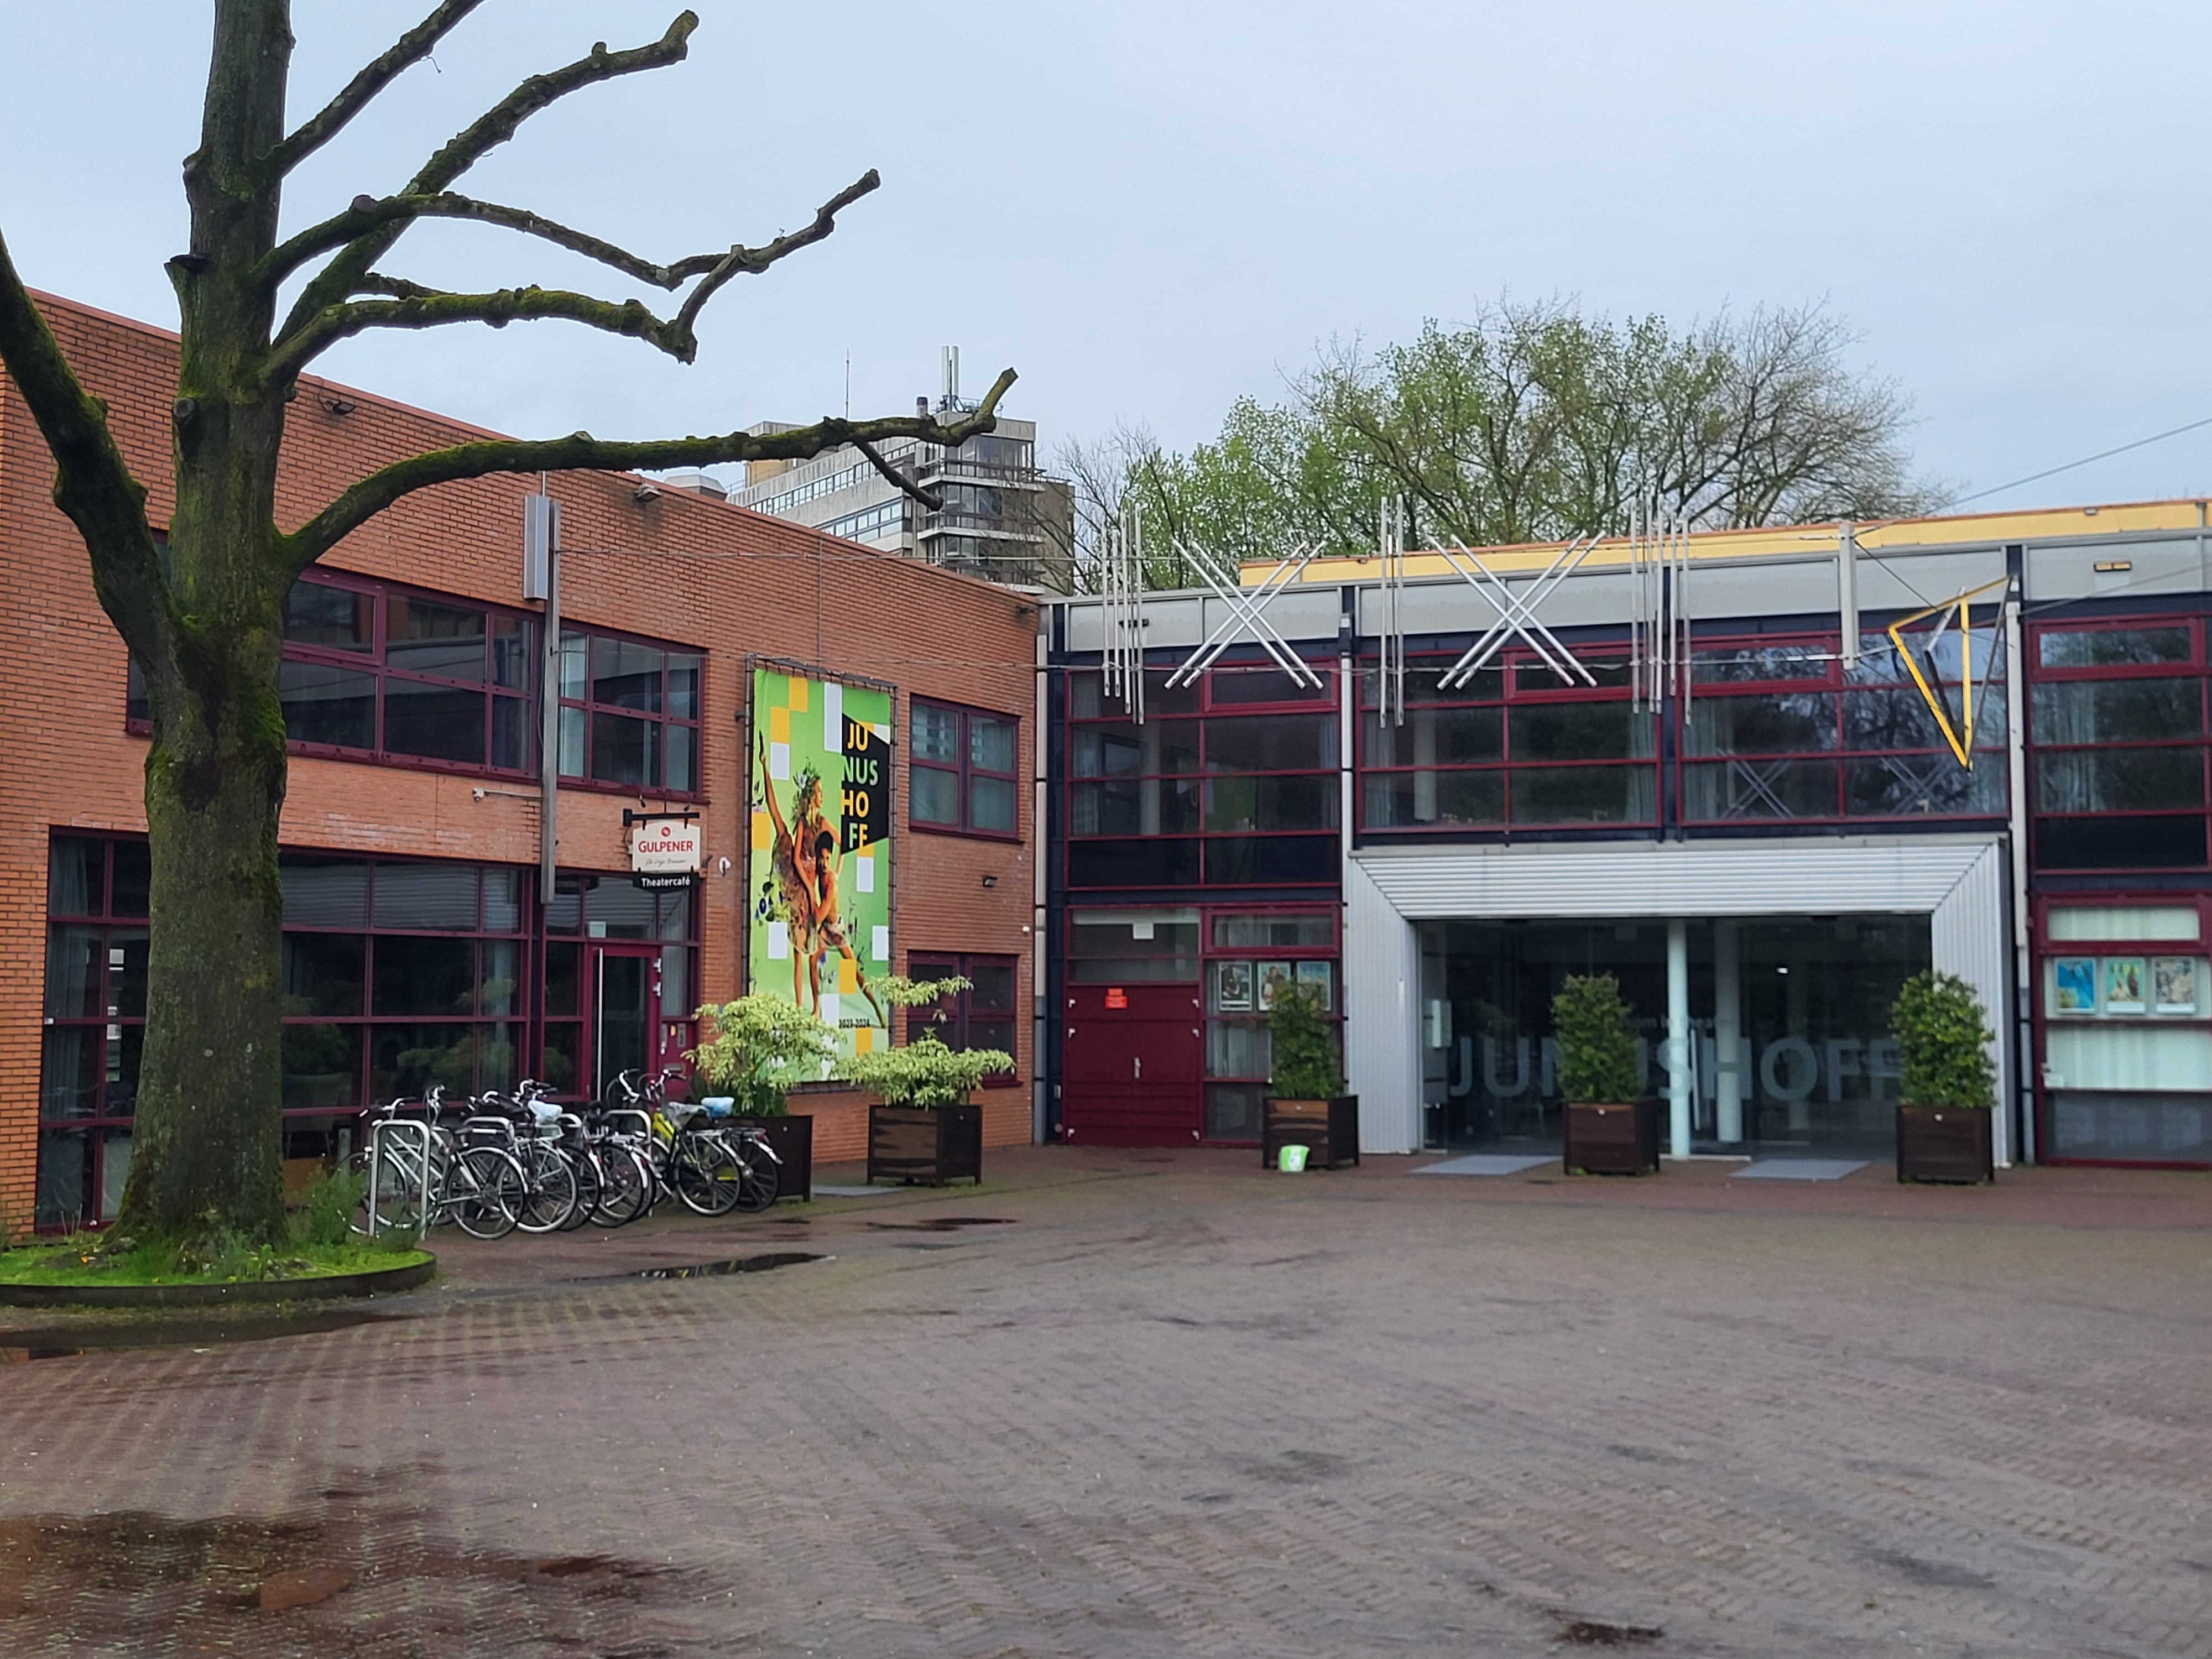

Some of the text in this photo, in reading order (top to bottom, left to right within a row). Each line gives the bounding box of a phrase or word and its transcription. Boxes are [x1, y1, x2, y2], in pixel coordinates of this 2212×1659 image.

[847, 723, 868, 751] JU
[842, 755, 878, 786] NUS
[841, 789, 869, 818] HO
[639, 841, 693, 853] GULPENER
[848, 823, 868, 849] FF
[641, 876, 690, 887] Theatercafé
[839, 1019, 870, 1029] 2023-2024
